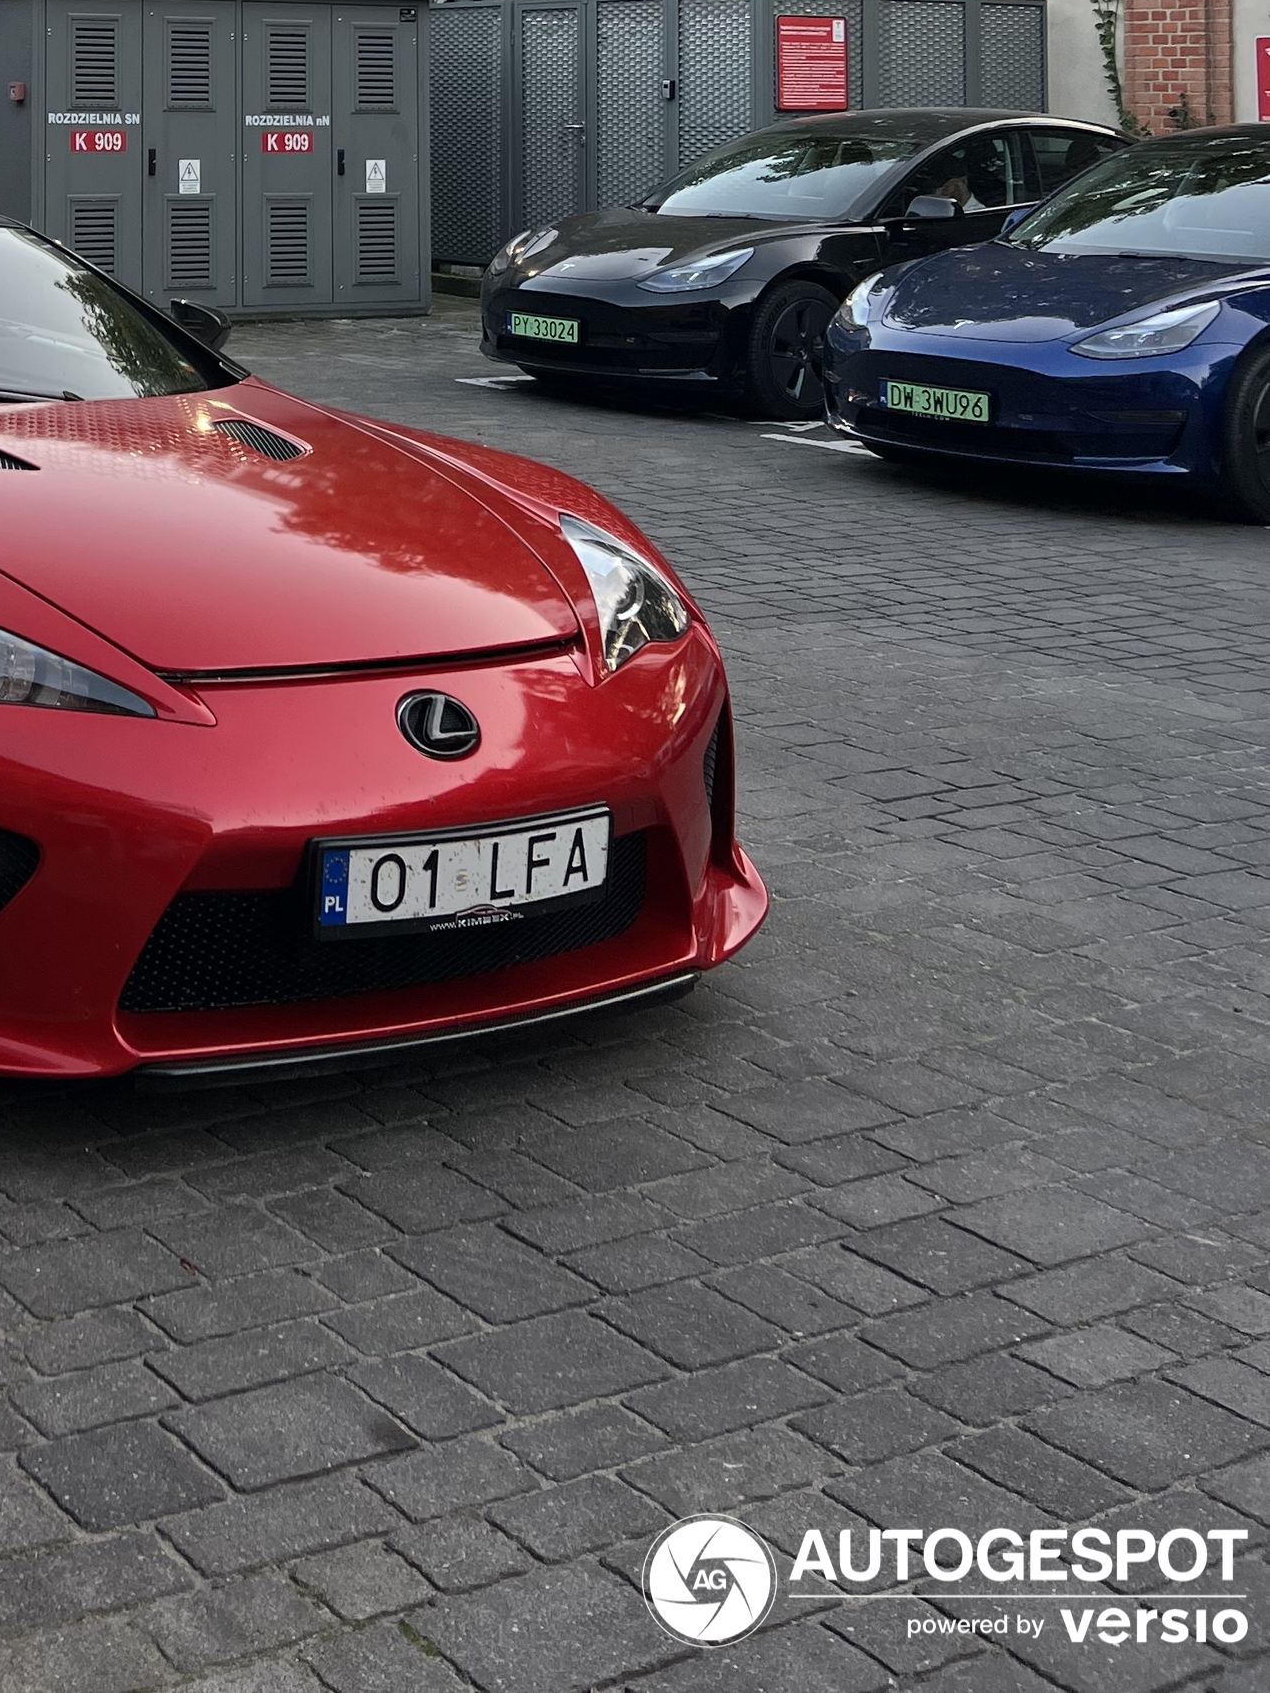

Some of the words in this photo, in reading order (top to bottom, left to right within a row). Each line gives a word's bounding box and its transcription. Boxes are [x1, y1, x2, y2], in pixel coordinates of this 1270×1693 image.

[47, 112, 122, 125] ROZDZIELNIA
[124, 113, 140, 125] SN
[245, 115, 314, 126] ROZDZIELNIA
[316, 115, 330, 126] nN
[75, 132, 88, 151] K
[94, 132, 122, 151] 909
[267, 133, 279, 151] K
[284, 133, 309, 151] 909
[513, 315, 529, 335] PY
[533, 318, 575, 341] 33024
[890, 384, 914, 409] DW
[921, 389, 983, 419] 3WU96
[489, 826, 589, 901] LFA
[324, 895, 344, 914] PL
